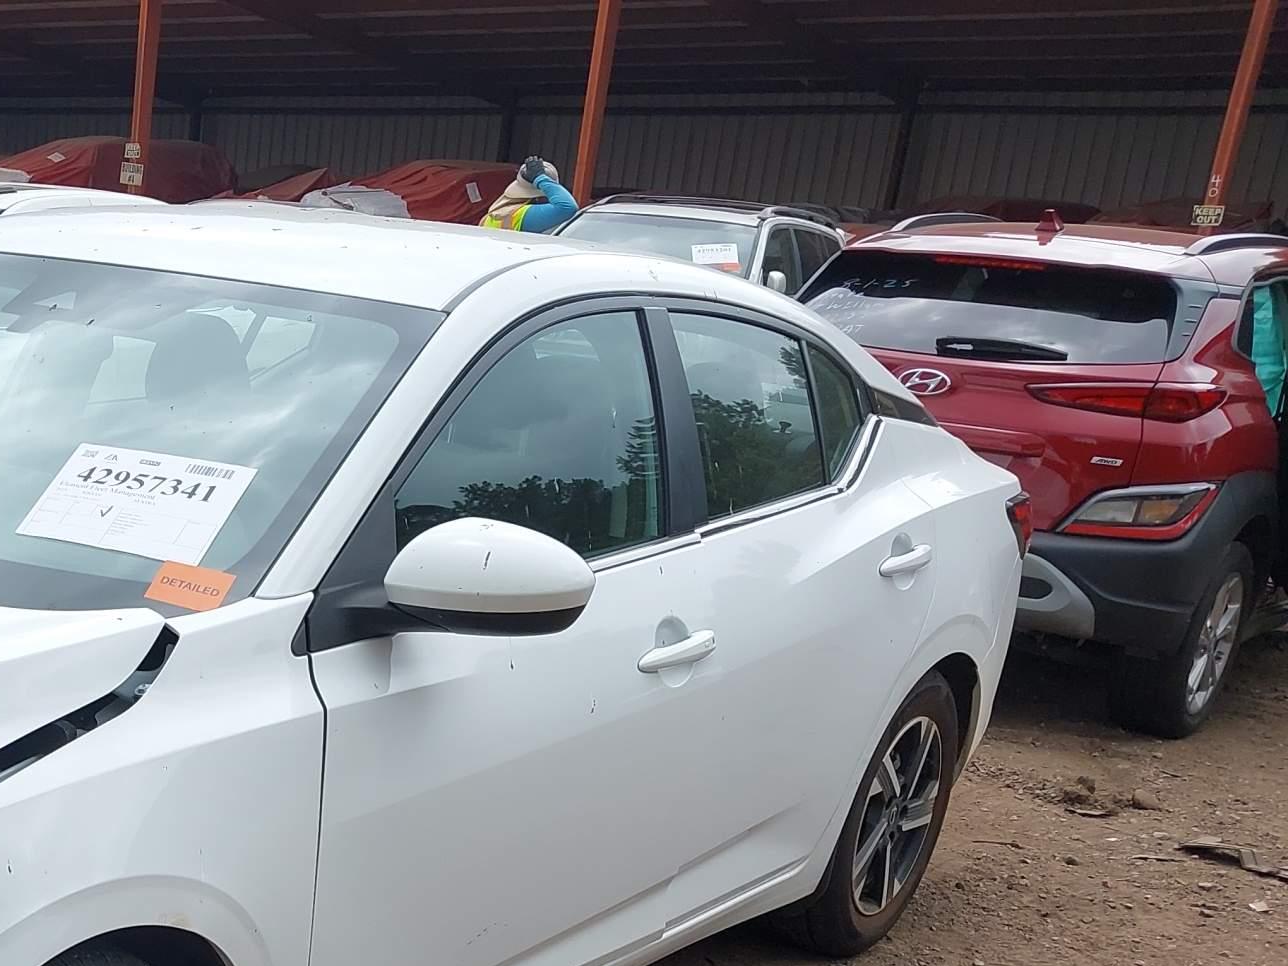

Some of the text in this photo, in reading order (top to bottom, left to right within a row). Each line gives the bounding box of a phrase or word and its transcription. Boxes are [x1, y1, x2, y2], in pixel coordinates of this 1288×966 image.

[1196, 215, 1218, 223] OUT
[76, 466, 217, 503] 42957341
[159, 575, 220, 598] DETAILED
